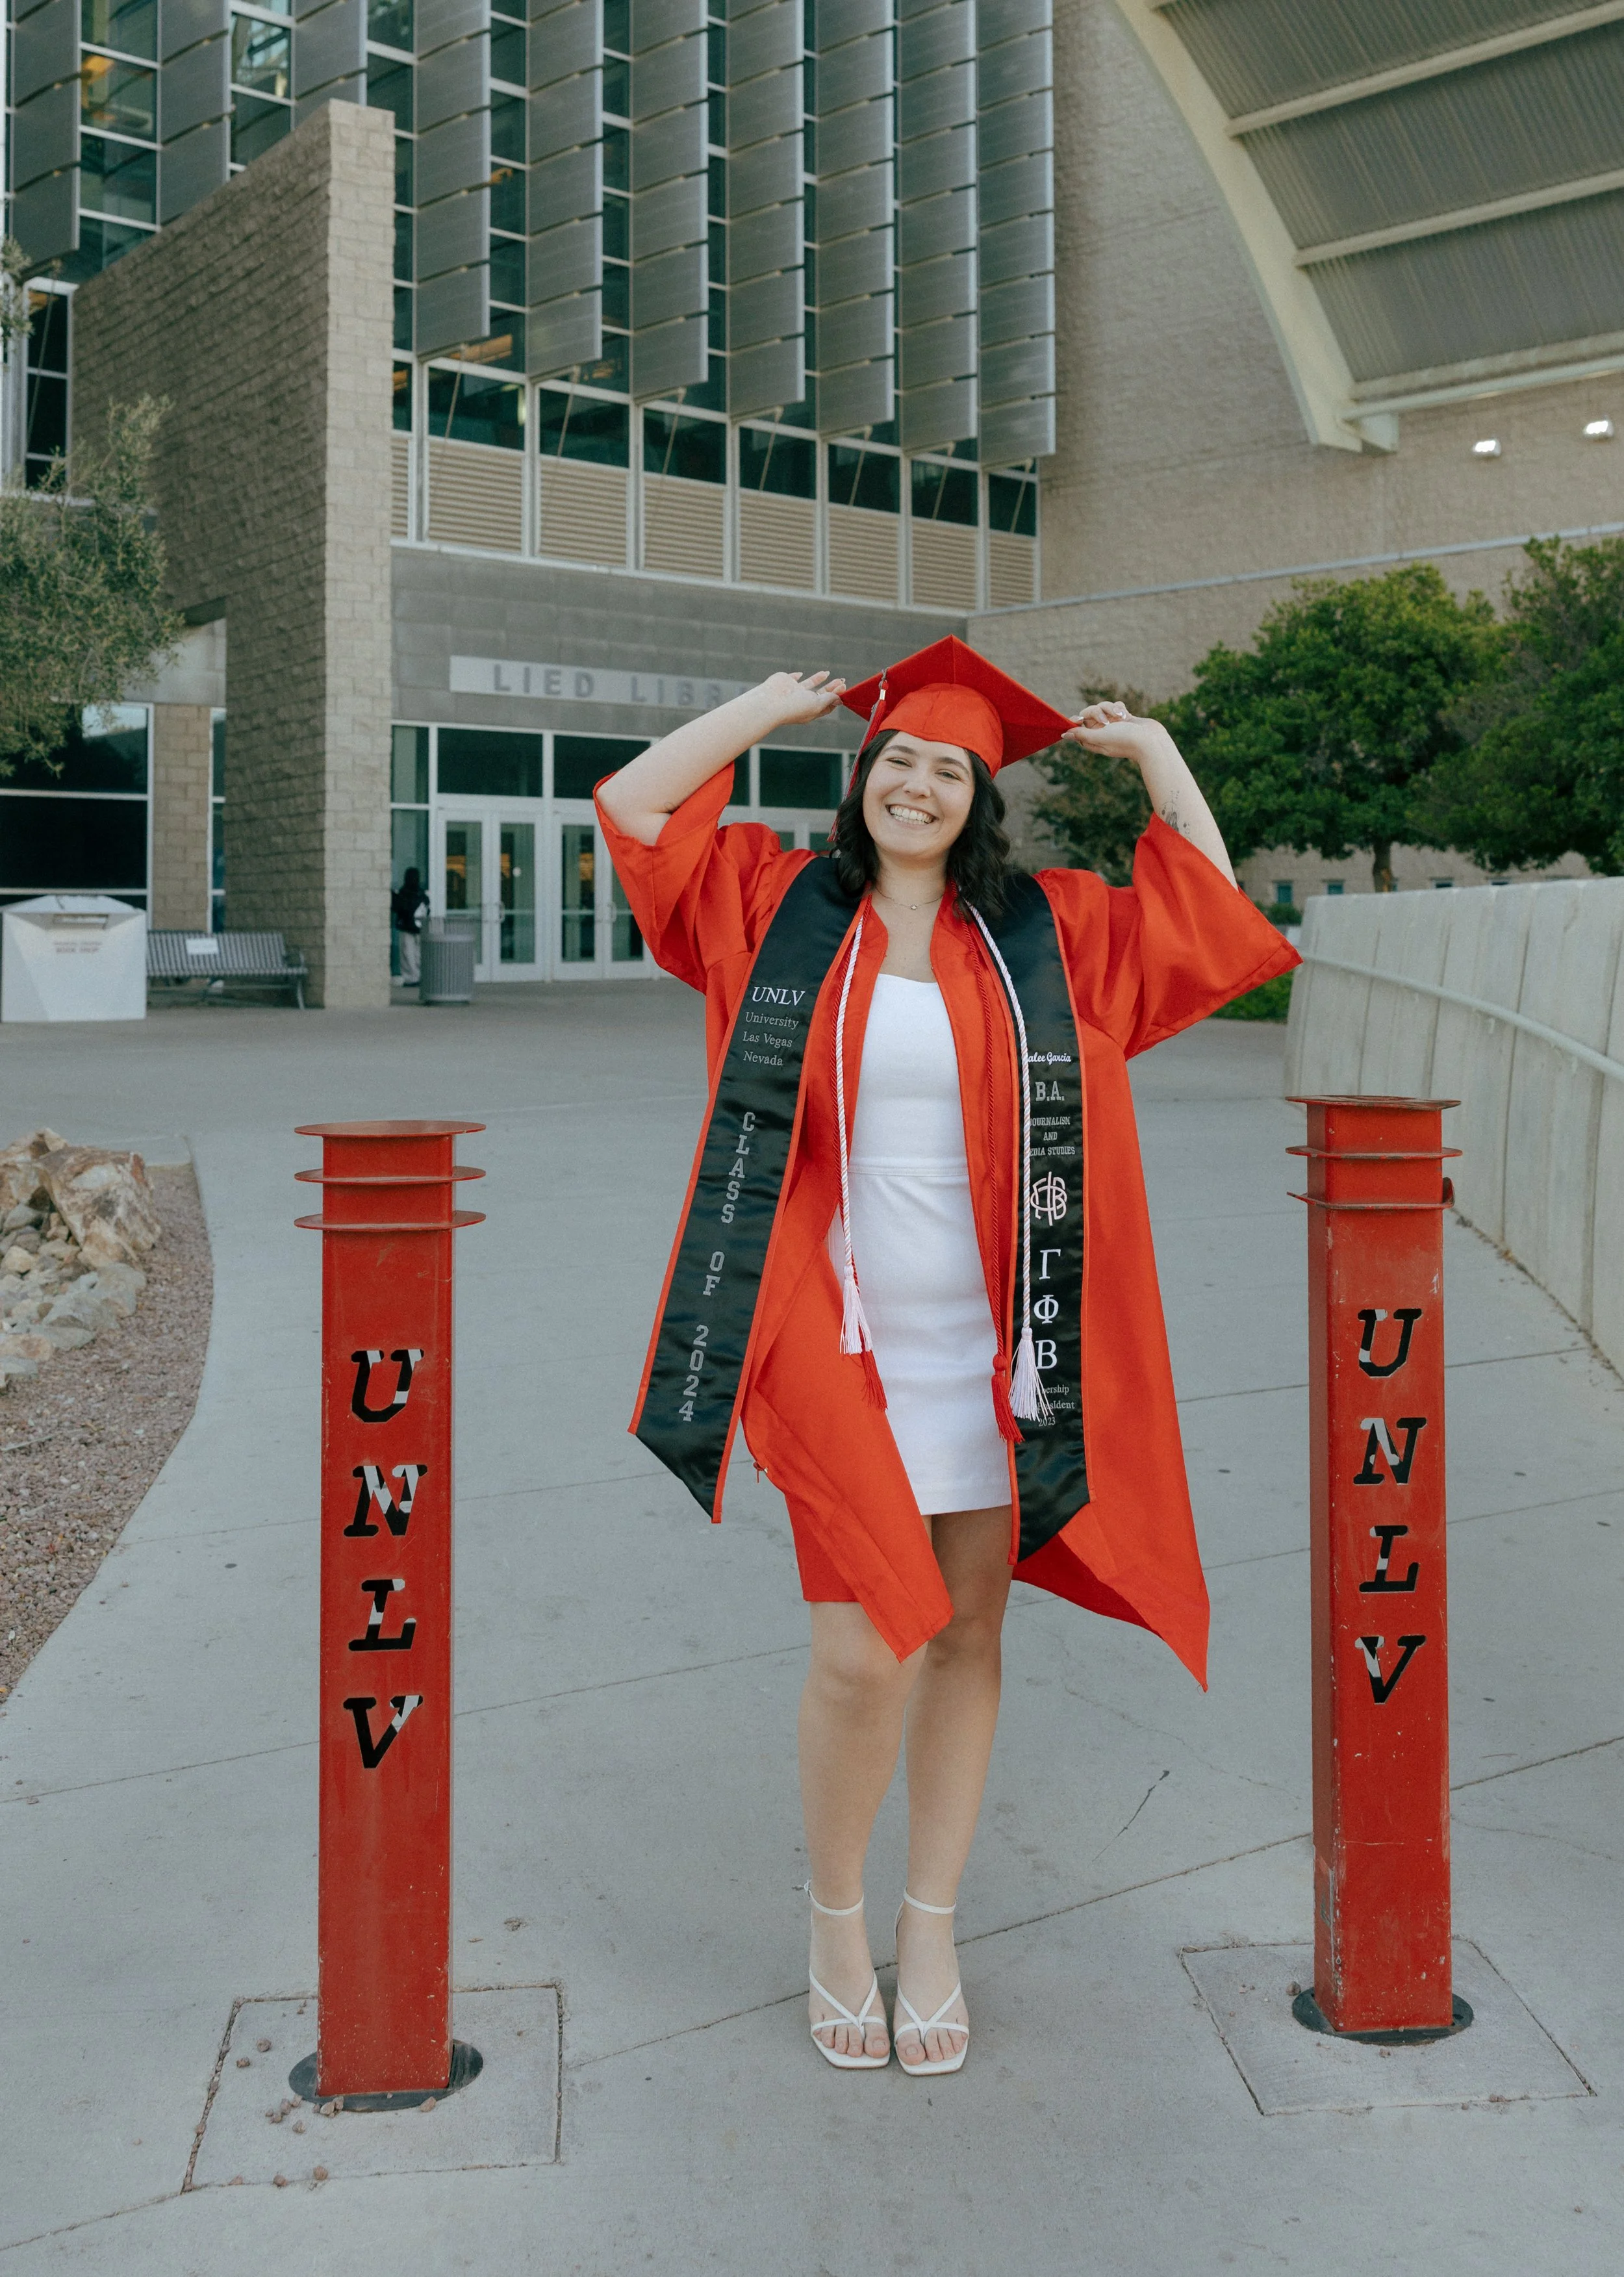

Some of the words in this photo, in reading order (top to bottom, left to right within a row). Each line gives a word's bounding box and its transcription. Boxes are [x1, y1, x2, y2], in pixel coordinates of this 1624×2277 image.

[492, 663, 595, 698] LIED
[630, 675, 748, 708] LIBR
[752, 986, 806, 1006] UNLV
[745, 1011, 799, 1030] University
[742, 1031, 760, 1043] Las
[763, 1033, 793, 1049] Vegas
[742, 1050, 784, 1066] Nevada
[1028, 1051, 1046, 1063] alee
[1047, 1051, 1071, 1065] Garcia
[1035, 1080, 1065, 1102] B.A.
[1043, 1132, 1058, 1141] AND
[1030, 1147, 1045, 1156] EDIA
[1048, 1146, 1076, 1156] STUDIES
[720, 1112, 755, 1224] CLASS
[703, 1251, 725, 1297] OF
[678, 1324, 709, 1422] 2024
[1039, 1417, 1056, 1427] 2023
[1353, 1308, 1427, 1705] UNLV
[343, 1348, 428, 1769] UNLV
